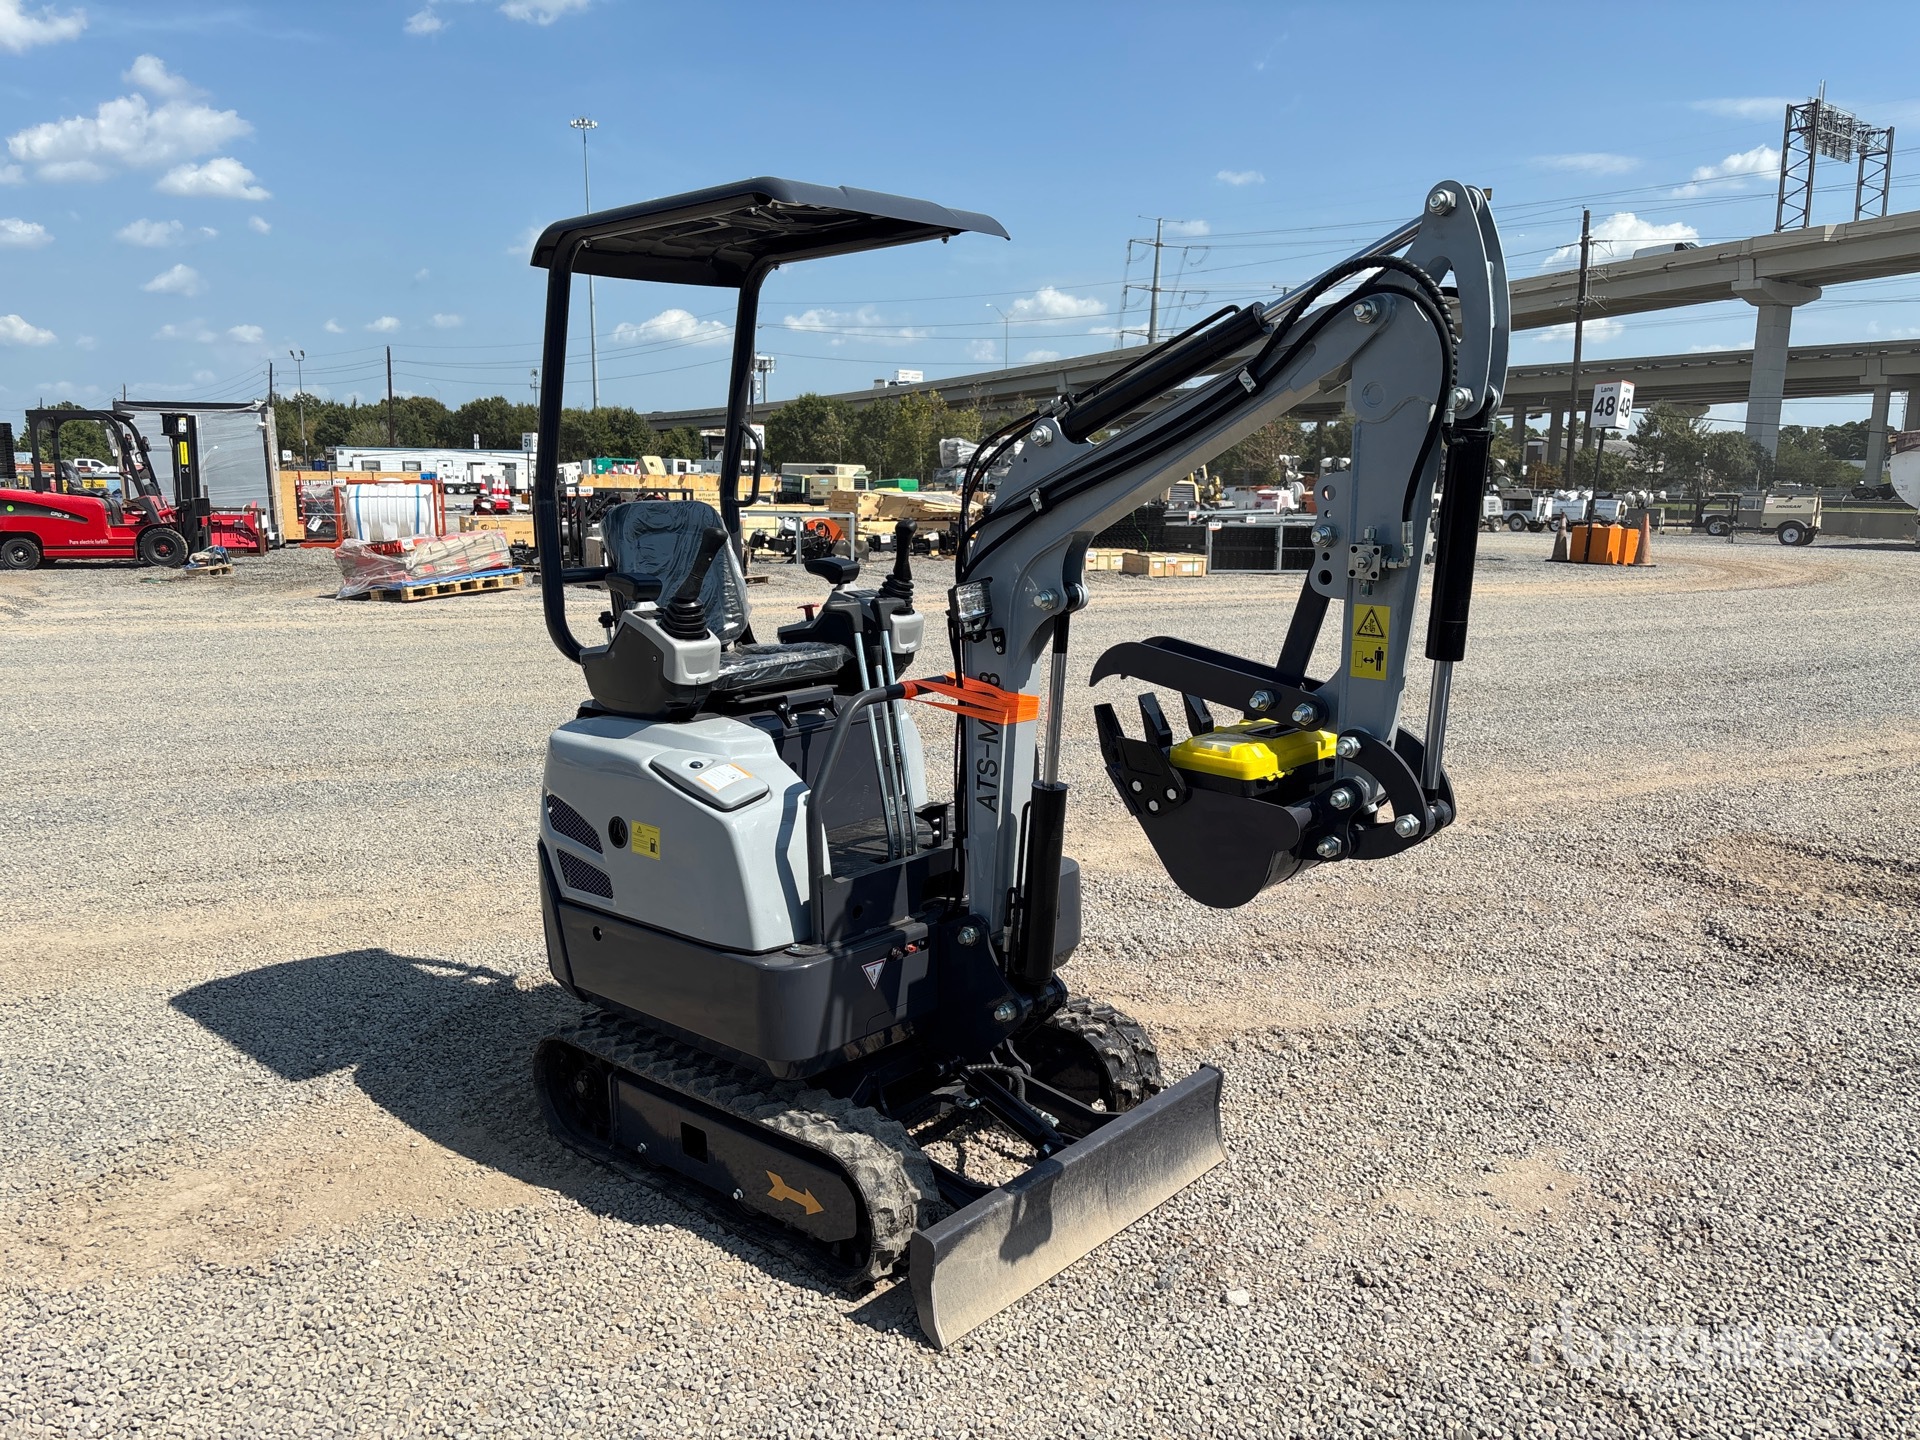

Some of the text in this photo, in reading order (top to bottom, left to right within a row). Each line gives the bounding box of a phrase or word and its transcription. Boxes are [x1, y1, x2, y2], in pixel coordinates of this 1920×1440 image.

[1594, 395, 1616, 417] 48
[1619, 396, 1631, 418] 48
[523, 438, 532, 448] 51
